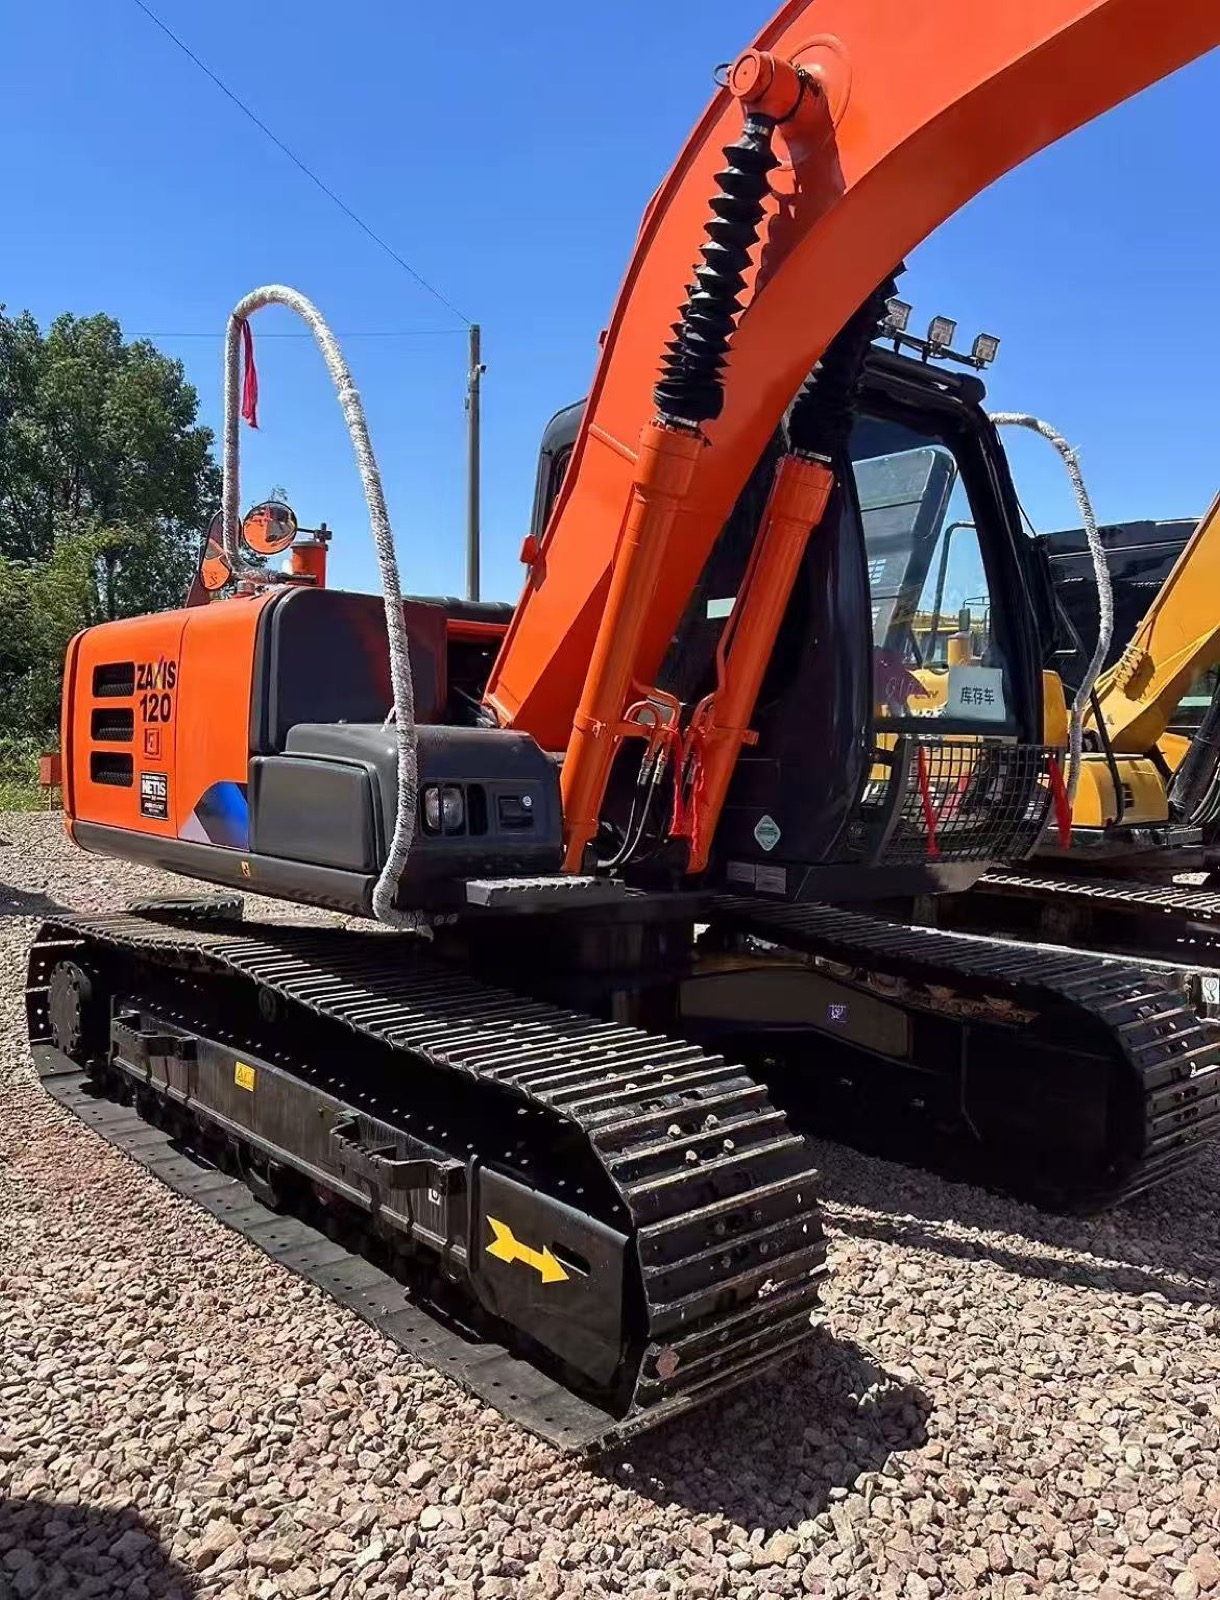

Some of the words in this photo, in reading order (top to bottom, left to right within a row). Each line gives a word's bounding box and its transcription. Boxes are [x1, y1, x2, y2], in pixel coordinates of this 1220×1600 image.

[137, 656, 176, 690] ZAXIS
[140, 693, 171, 722] 120
[960, 687, 995, 705] 库存车
[141, 779, 166, 796] NETIS
